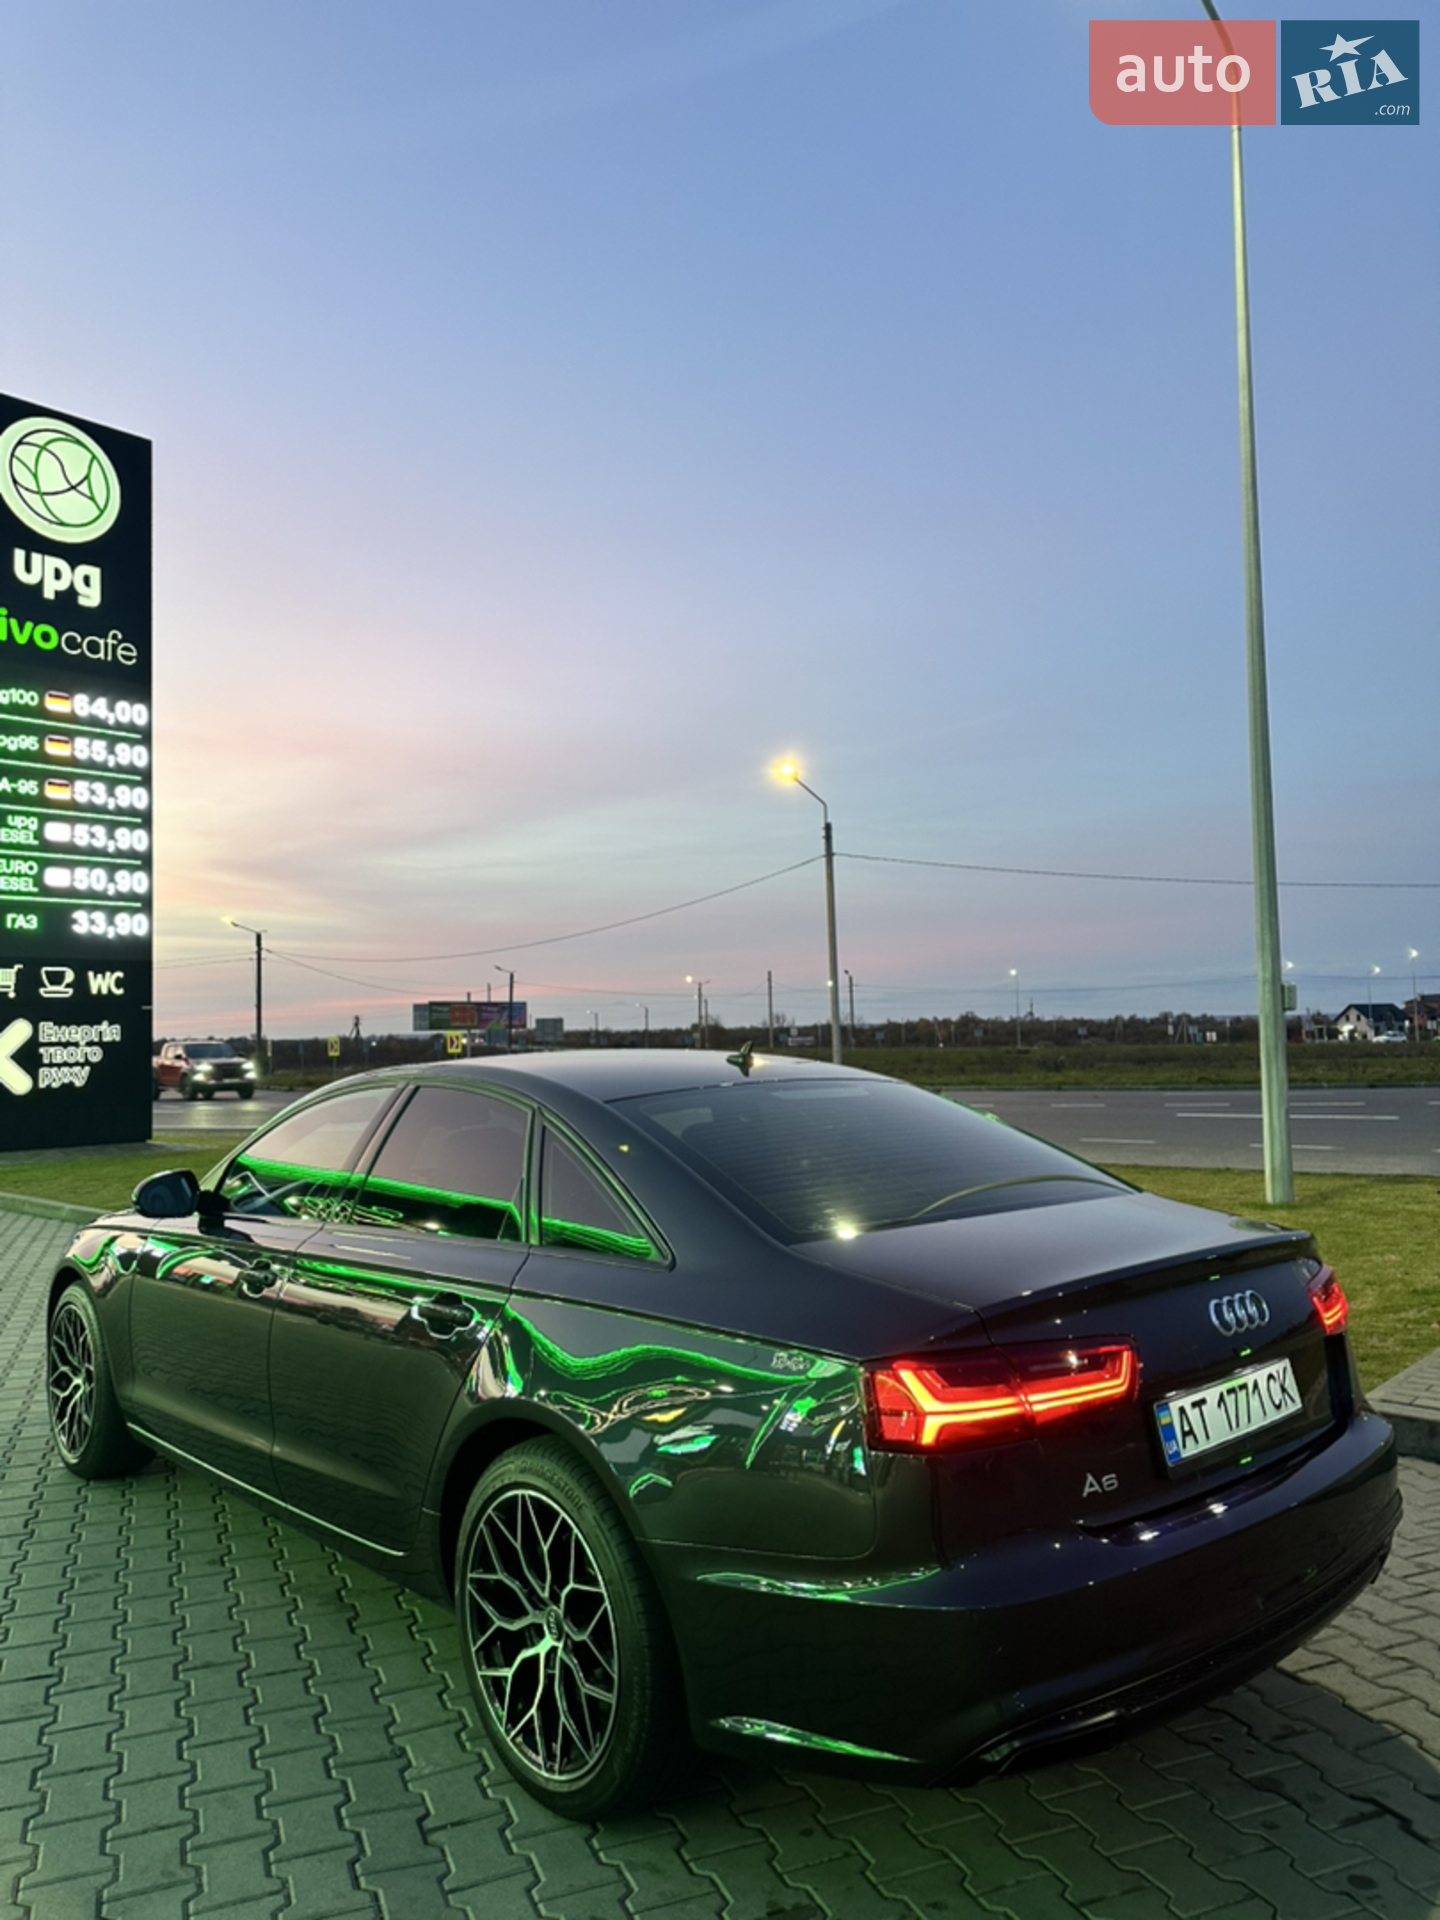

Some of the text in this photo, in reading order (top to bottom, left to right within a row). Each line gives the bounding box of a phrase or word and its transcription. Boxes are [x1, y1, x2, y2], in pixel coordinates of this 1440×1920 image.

[13, 547, 102, 608] upg
[73, 693, 149, 726] 64,00
[73, 736, 149, 768] 55,90
[73, 780, 149, 810] 53,90
[7, 814, 39, 831] upg
[73, 823, 149, 853] 53,90
[73, 866, 149, 896] 50,90
[6, 910, 149, 939] ГАЗ 33,90
[87, 970, 125, 995] WC
[38, 1019, 122, 1047] Енергія
[38, 1046, 104, 1064] твого
[38, 1066, 91, 1089] руху
[1177, 1366, 1296, 1450] AT 1771 CK
[1082, 1472, 1119, 1498] A6
